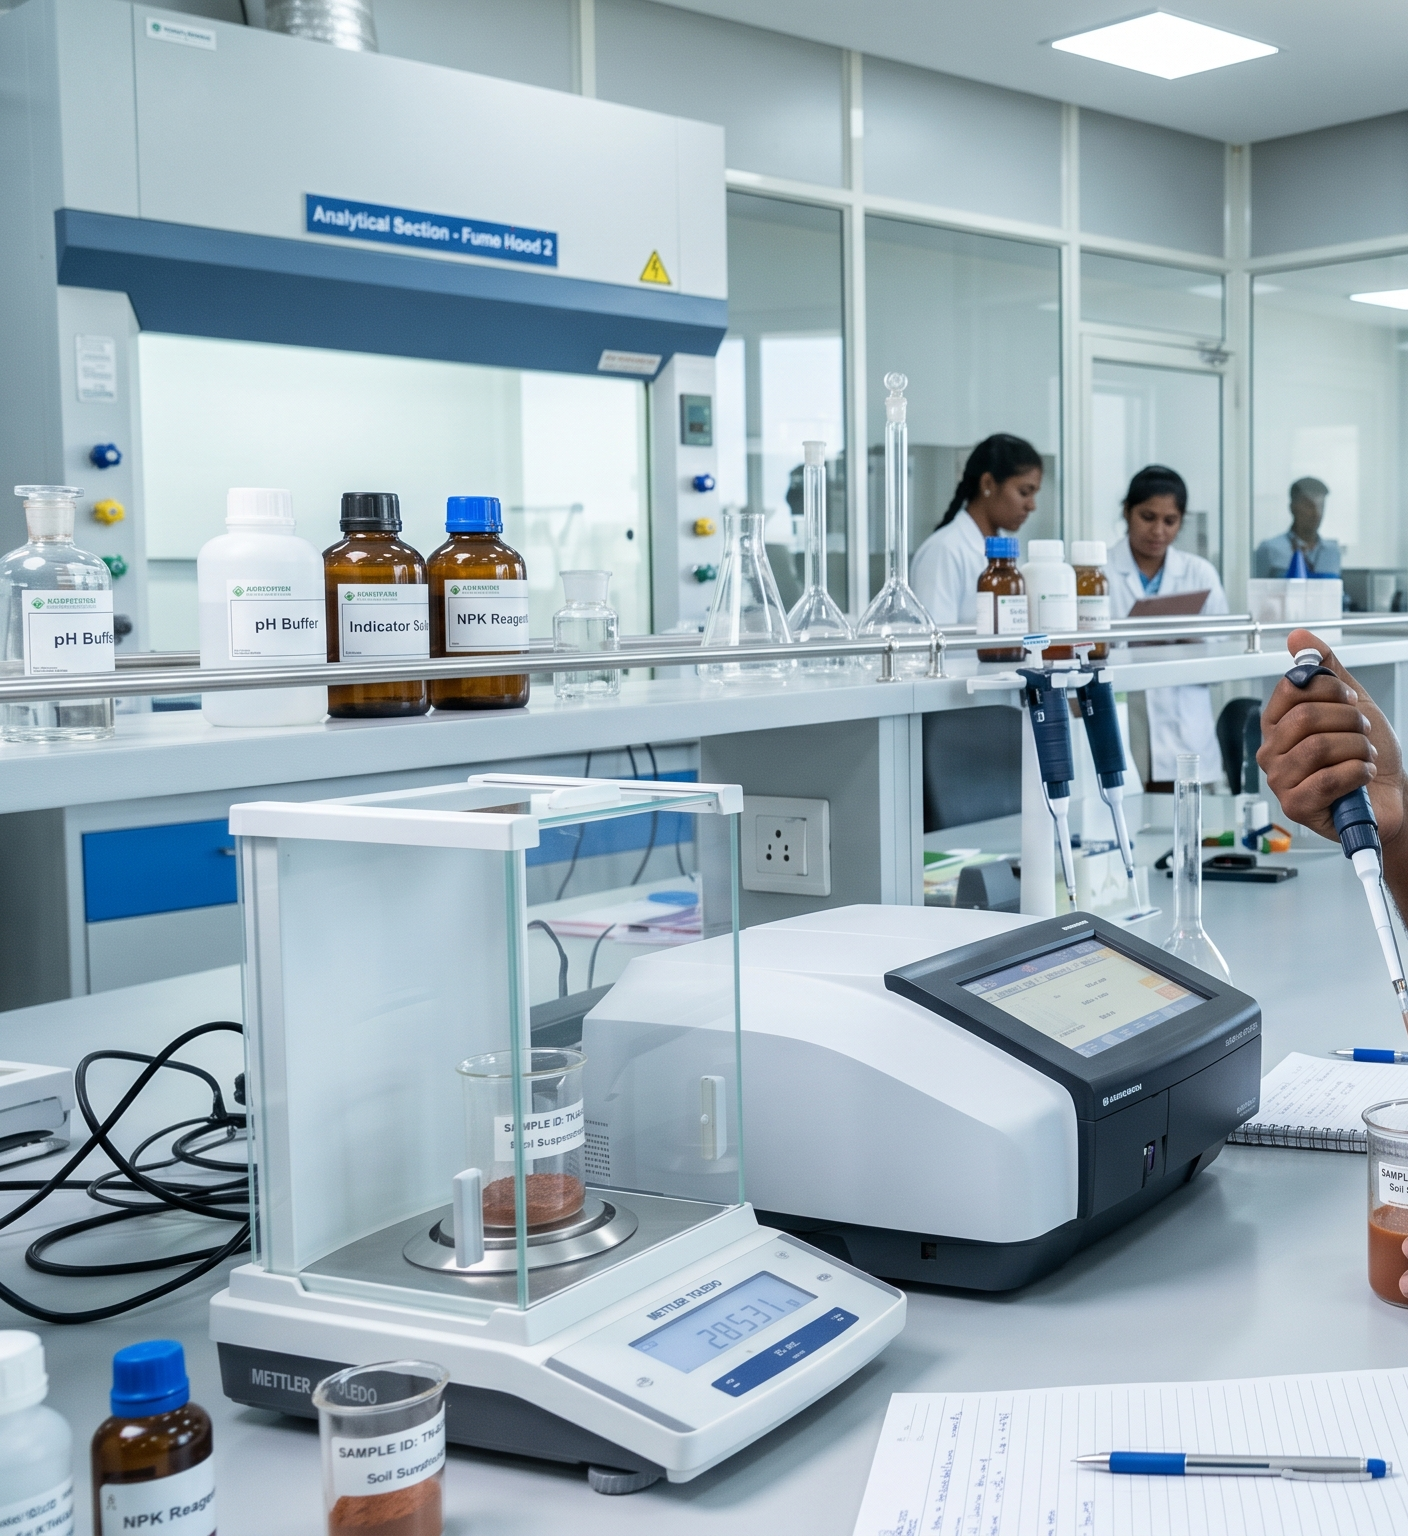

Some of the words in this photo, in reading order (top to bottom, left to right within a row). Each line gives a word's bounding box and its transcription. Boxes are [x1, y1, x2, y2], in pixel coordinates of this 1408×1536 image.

[313, 204, 390, 232] Analytical
[393, 216, 449, 241] Section
[504, 233, 541, 255] Hood
[543, 238, 553, 256] 2
[254, 618, 276, 634] pH
[281, 617, 319, 630] Buffer
[349, 620, 411, 633] Indicator
[457, 613, 487, 625] NPK
[54, 632, 77, 649] pH
[1389, 1183, 1404, 1193] Soil
[252, 1368, 311, 1394] METTLER
[336, 1380, 378, 1404] LEDO
[339, 1442, 396, 1458] SAMPLE
[400, 1438, 418, 1452] ID:
[367, 1470, 392, 1484] Soil
[123, 1510, 163, 1529] NPK
